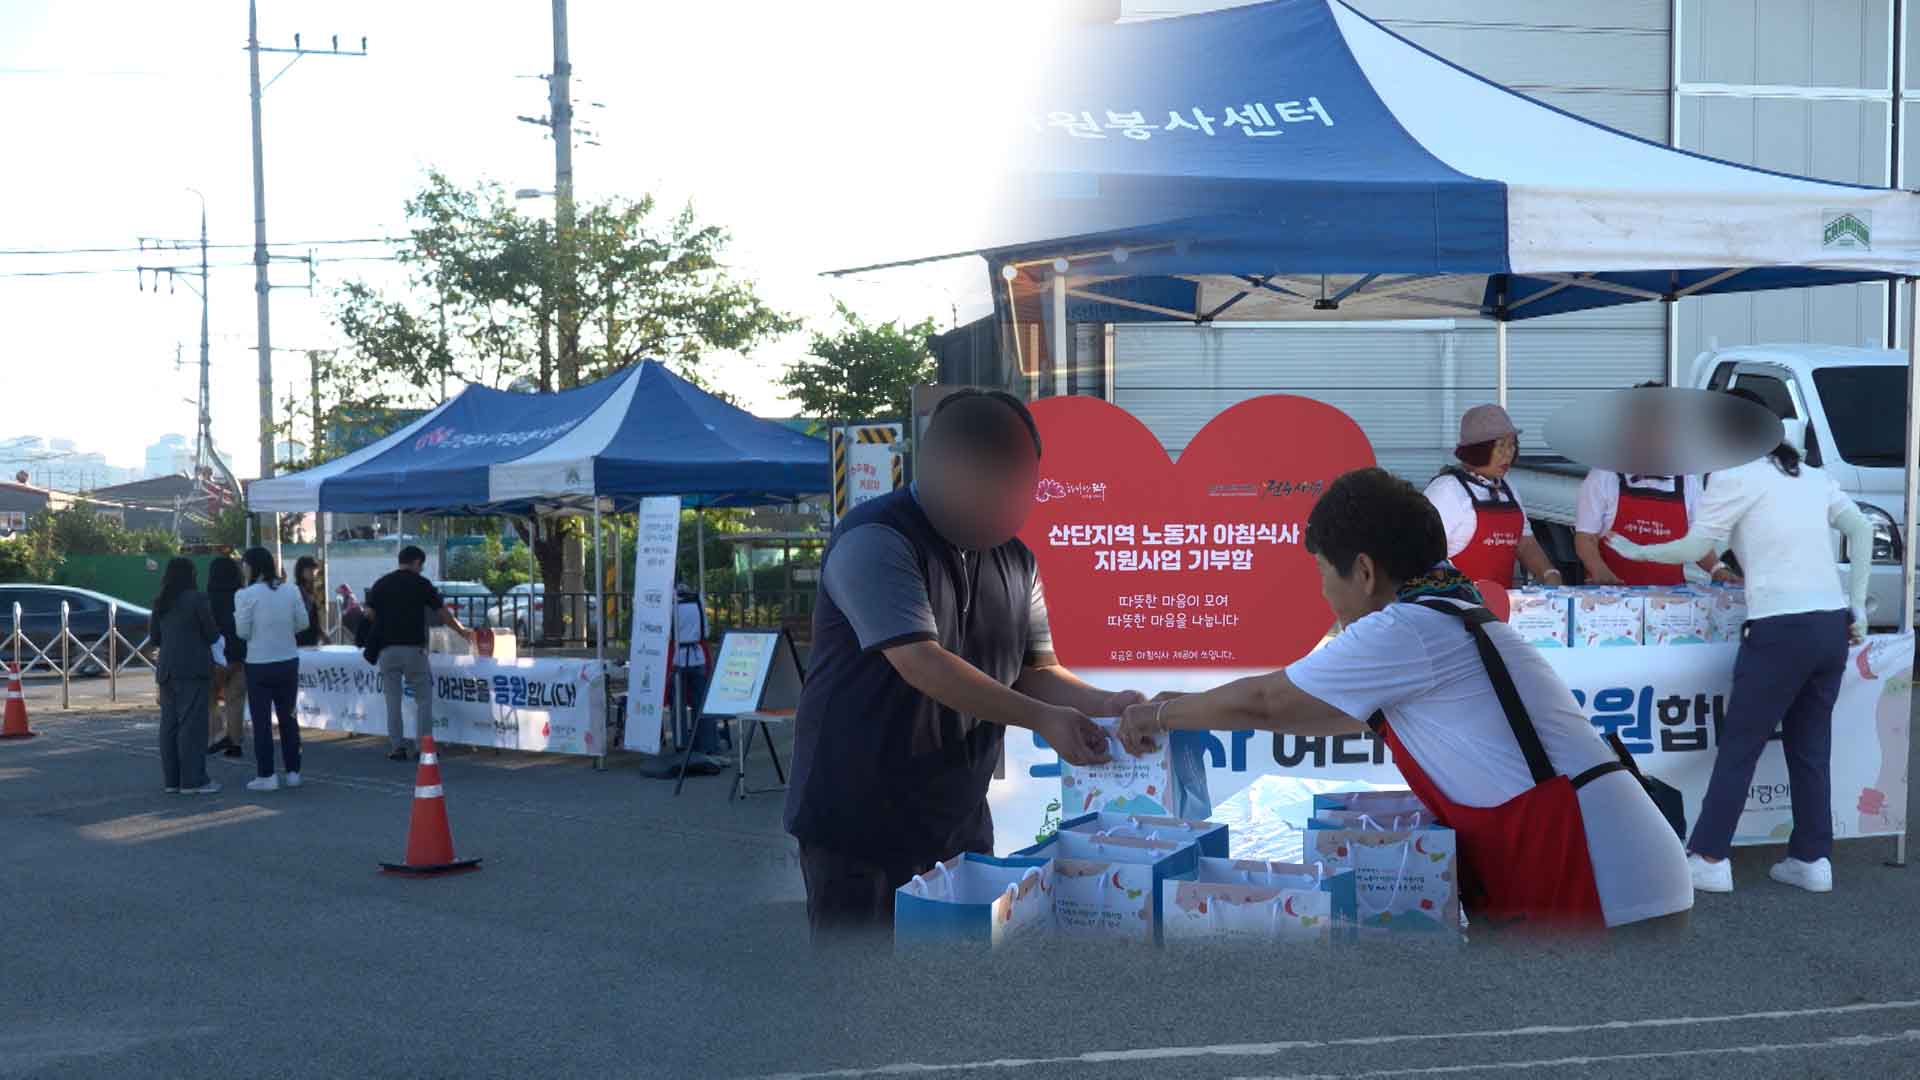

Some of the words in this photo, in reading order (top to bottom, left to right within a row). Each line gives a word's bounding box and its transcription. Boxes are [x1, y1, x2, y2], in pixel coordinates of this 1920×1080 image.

[1048, 524, 1135, 546] 산단지역
[1141, 524, 1207, 546] 노동자
[1213, 524, 1300, 545] 아침식사
[1095, 550, 1181, 571] 지원사업
[1188, 550, 1254, 571] 기부함
[1119, 594, 1157, 608] 따뜻한
[1162, 594, 1200, 607] 마음이
[1203, 594, 1229, 607] 모여
[1107, 614, 1146, 628] 따뜻한
[1151, 614, 1187, 628] 마음을
[1136, 650, 1169, 661] 아침식사
[438, 676, 489, 703] 여러분을
